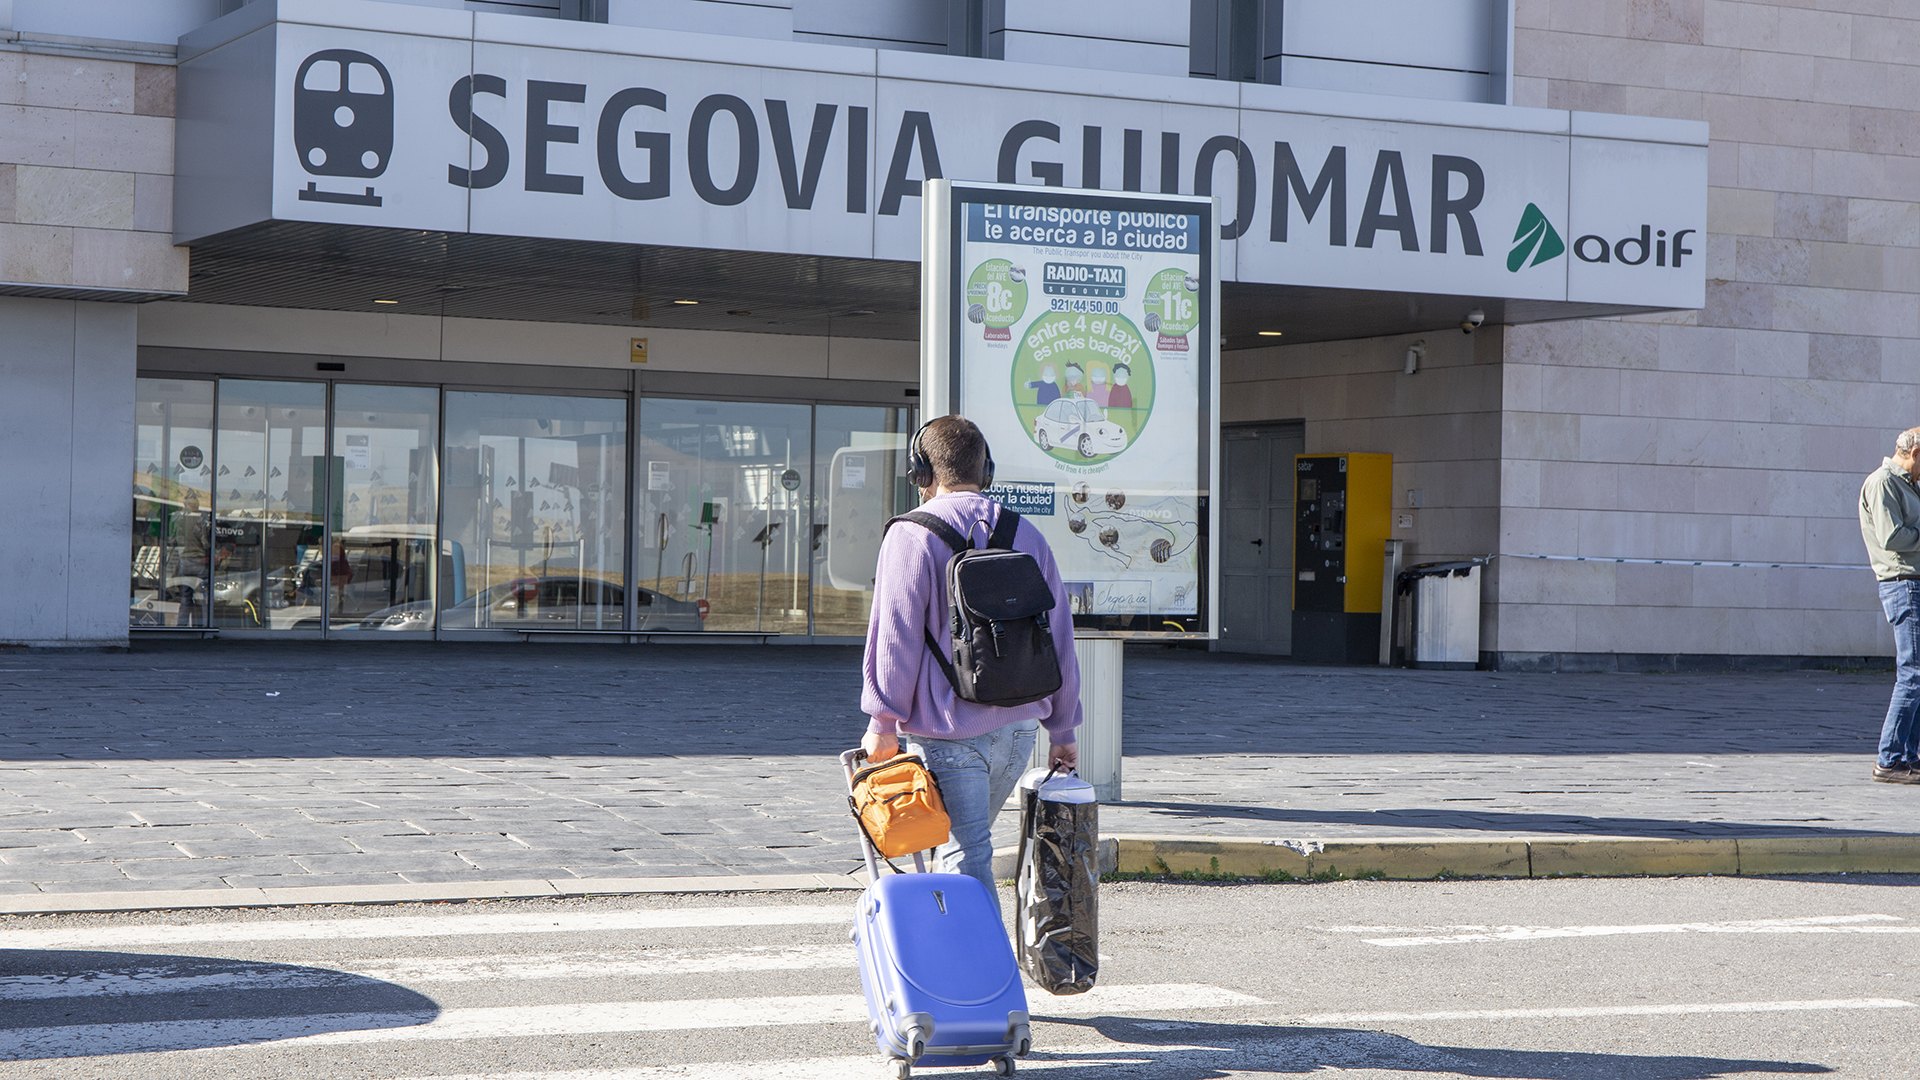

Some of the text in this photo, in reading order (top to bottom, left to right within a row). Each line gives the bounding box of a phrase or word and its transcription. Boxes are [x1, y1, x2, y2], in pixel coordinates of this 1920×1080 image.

[447, 73, 925, 217] SEGOVIA
[1009, 205, 1112, 226] transporte
[984, 220, 1188, 251] te acerca a la ciudad
[1573, 223, 1697, 270] adif
[1032, 247, 1044, 255] The
[1044, 247, 1063, 256] Public
[1090, 252, 1102, 260] you
[1102, 250, 1119, 259] about
[1120, 252, 1131, 260] the
[1131, 253, 1144, 262] City
[985, 263, 1009, 273] Estación
[1046, 265, 1123, 284] RADIO-TAXI
[986, 272, 1007, 282] del AVE
[1160, 272, 1184, 282] Estación
[1048, 285, 1121, 296] SEGOVIA
[1161, 281, 1182, 291] del AVE
[986, 281, 1013, 313] 8€
[1051, 298, 1119, 313] 921 44 50 00
[1160, 291, 1193, 321] 11€
[985, 314, 1015, 323] Acueducto
[1161, 322, 1190, 331] Acueducto
[1027, 315, 1143, 355] entre 4 el taxi
[1033, 334, 1132, 366] es más barato
[1054, 460, 1066, 472] Taxi
[1065, 464, 1078, 474] from
[1077, 467, 1082, 475] 4
[1340, 459, 1346, 470] P
[1016, 483, 1054, 495] nuestra
[1007, 493, 1018, 504] la
[1019, 494, 1052, 505] ciudad
[1041, 507, 1052, 515] city
[1096, 583, 1148, 613] Segovia
